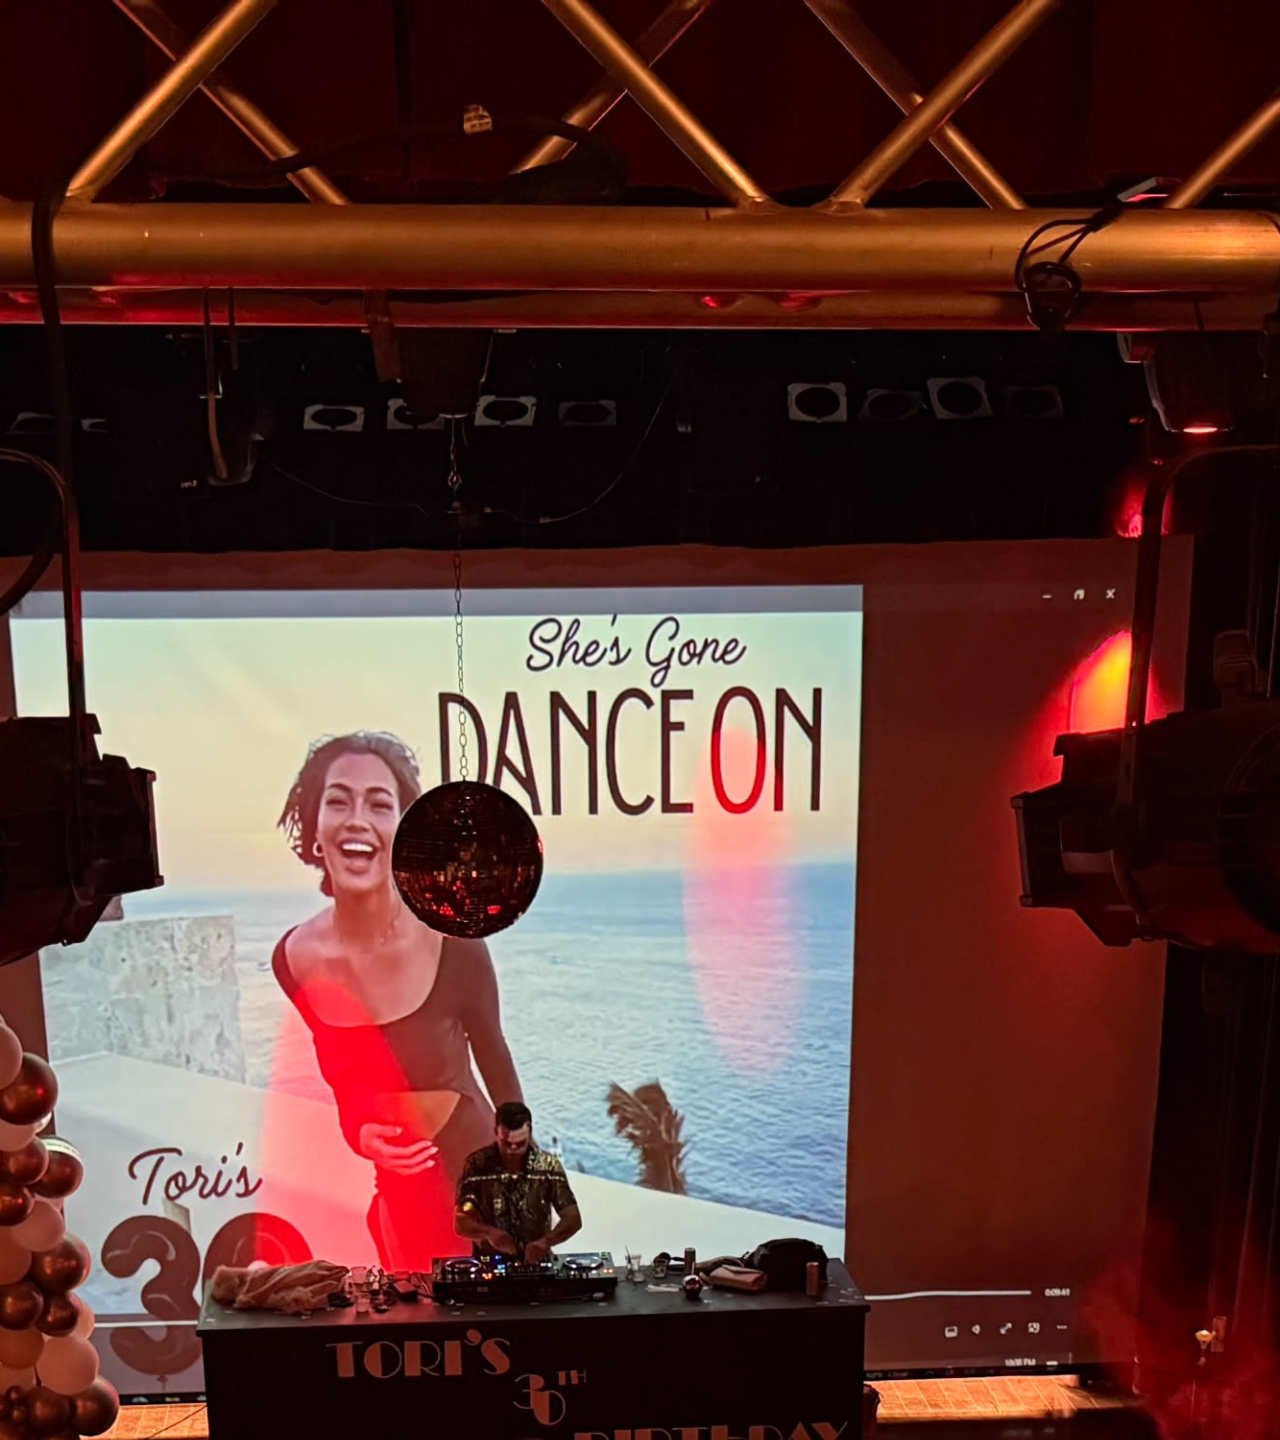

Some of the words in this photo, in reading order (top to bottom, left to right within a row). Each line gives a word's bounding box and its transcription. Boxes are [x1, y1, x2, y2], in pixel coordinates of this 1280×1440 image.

[526, 613, 632, 672] She's
[645, 615, 747, 688] Gone
[437, 686, 695, 817] DANCE
[710, 685, 823, 815] ON
[127, 1141, 263, 1206] Tori's
[325, 1328, 511, 1378] TORI'S
